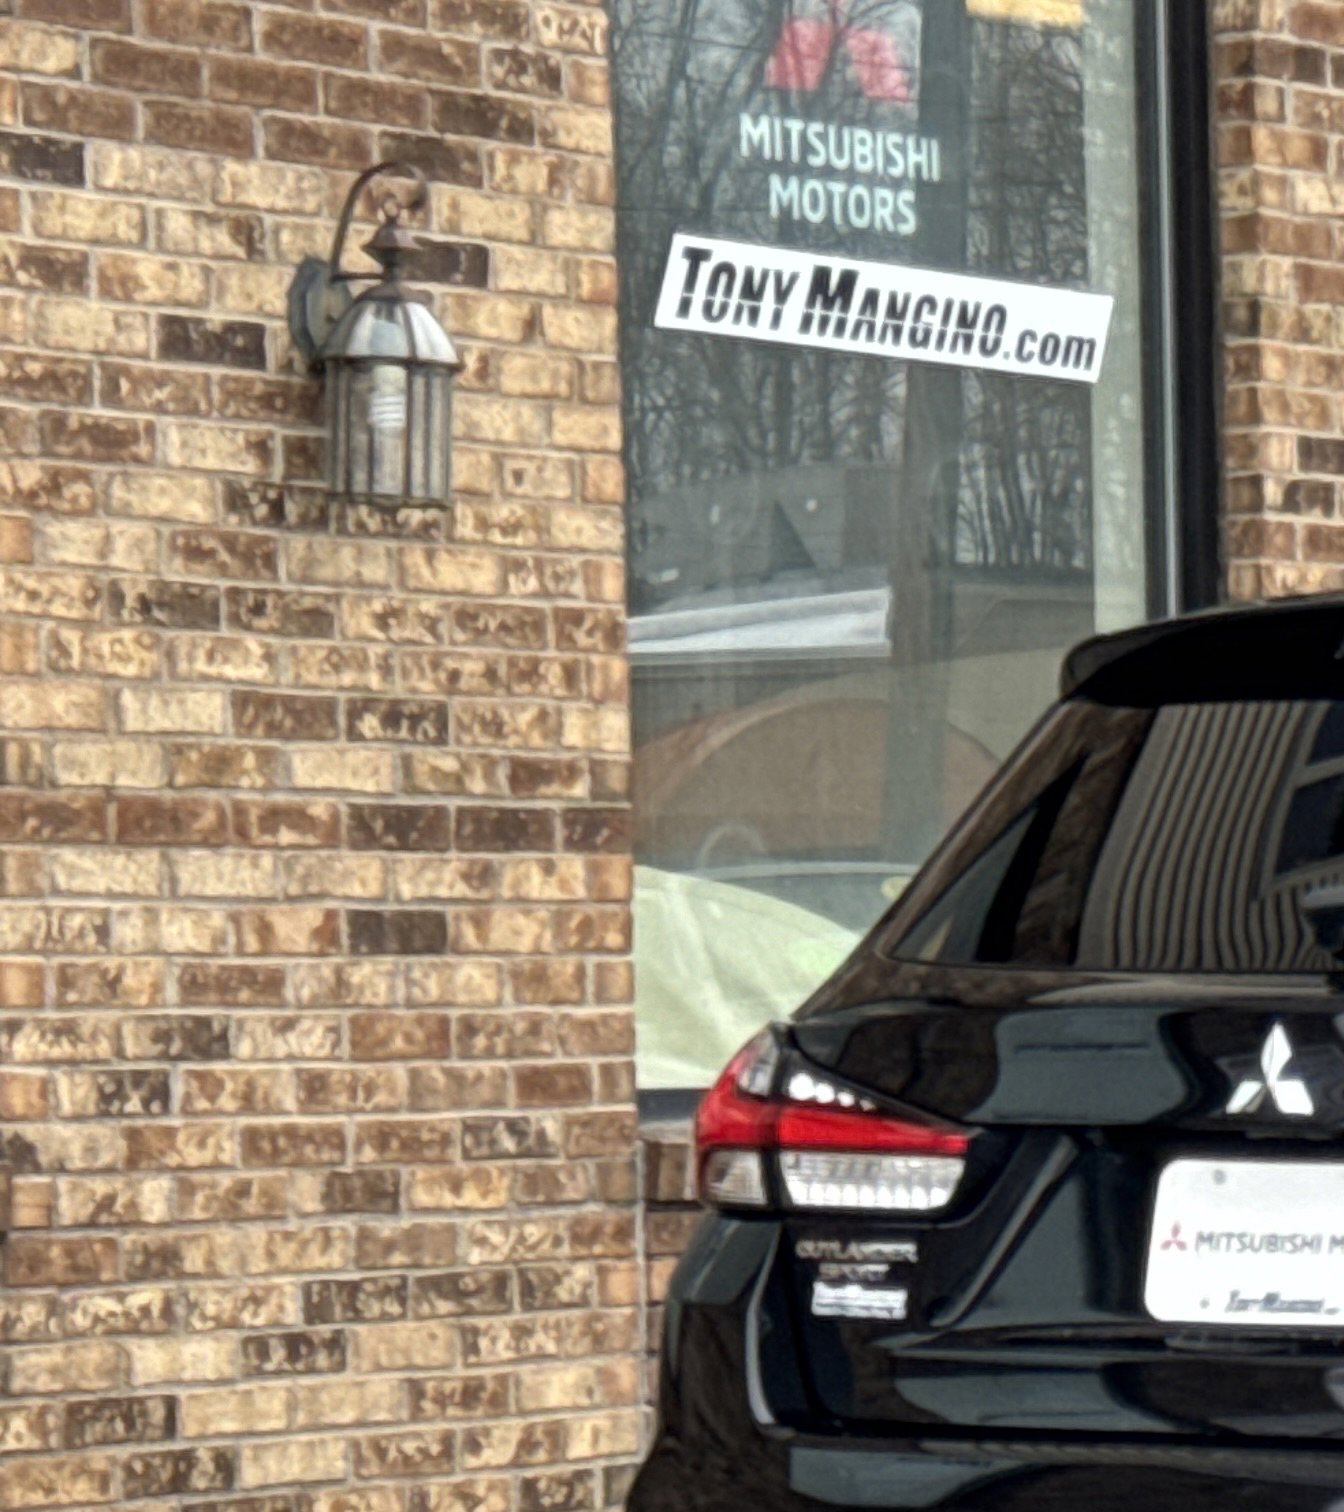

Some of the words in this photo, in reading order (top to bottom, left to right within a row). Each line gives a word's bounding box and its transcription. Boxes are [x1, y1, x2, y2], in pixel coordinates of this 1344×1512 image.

[739, 112, 940, 182] MITSUBISHI
[768, 174, 916, 236] MOTORS
[1195, 1231, 1323, 1256] MITSUBISHI
